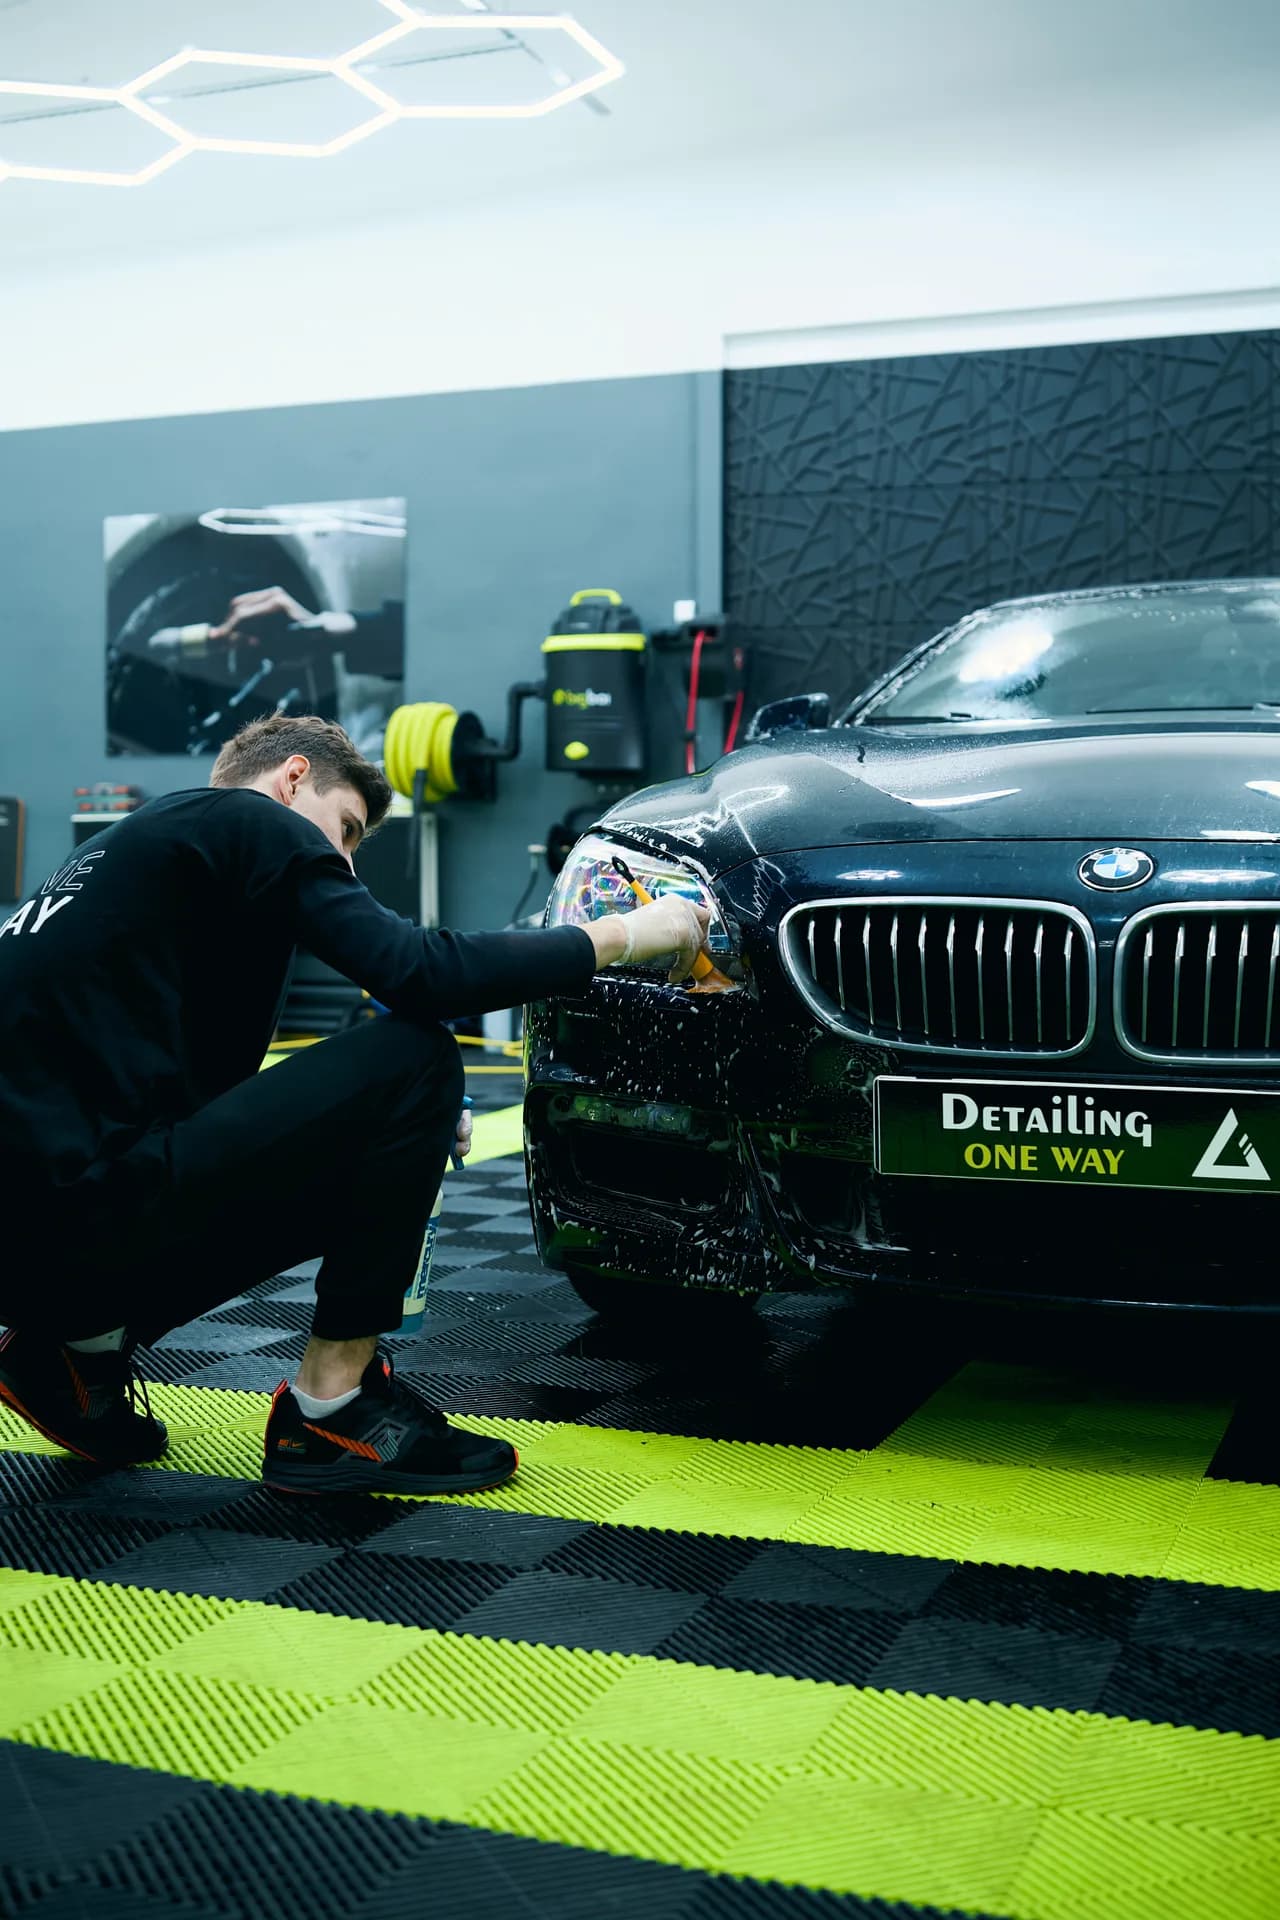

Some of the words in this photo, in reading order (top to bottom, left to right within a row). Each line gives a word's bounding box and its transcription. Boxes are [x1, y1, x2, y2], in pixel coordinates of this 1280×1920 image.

[0, 896, 74, 938] AY
[963, 1142, 1039, 1172] ONE
[1050, 1145, 1125, 1176] WAY
